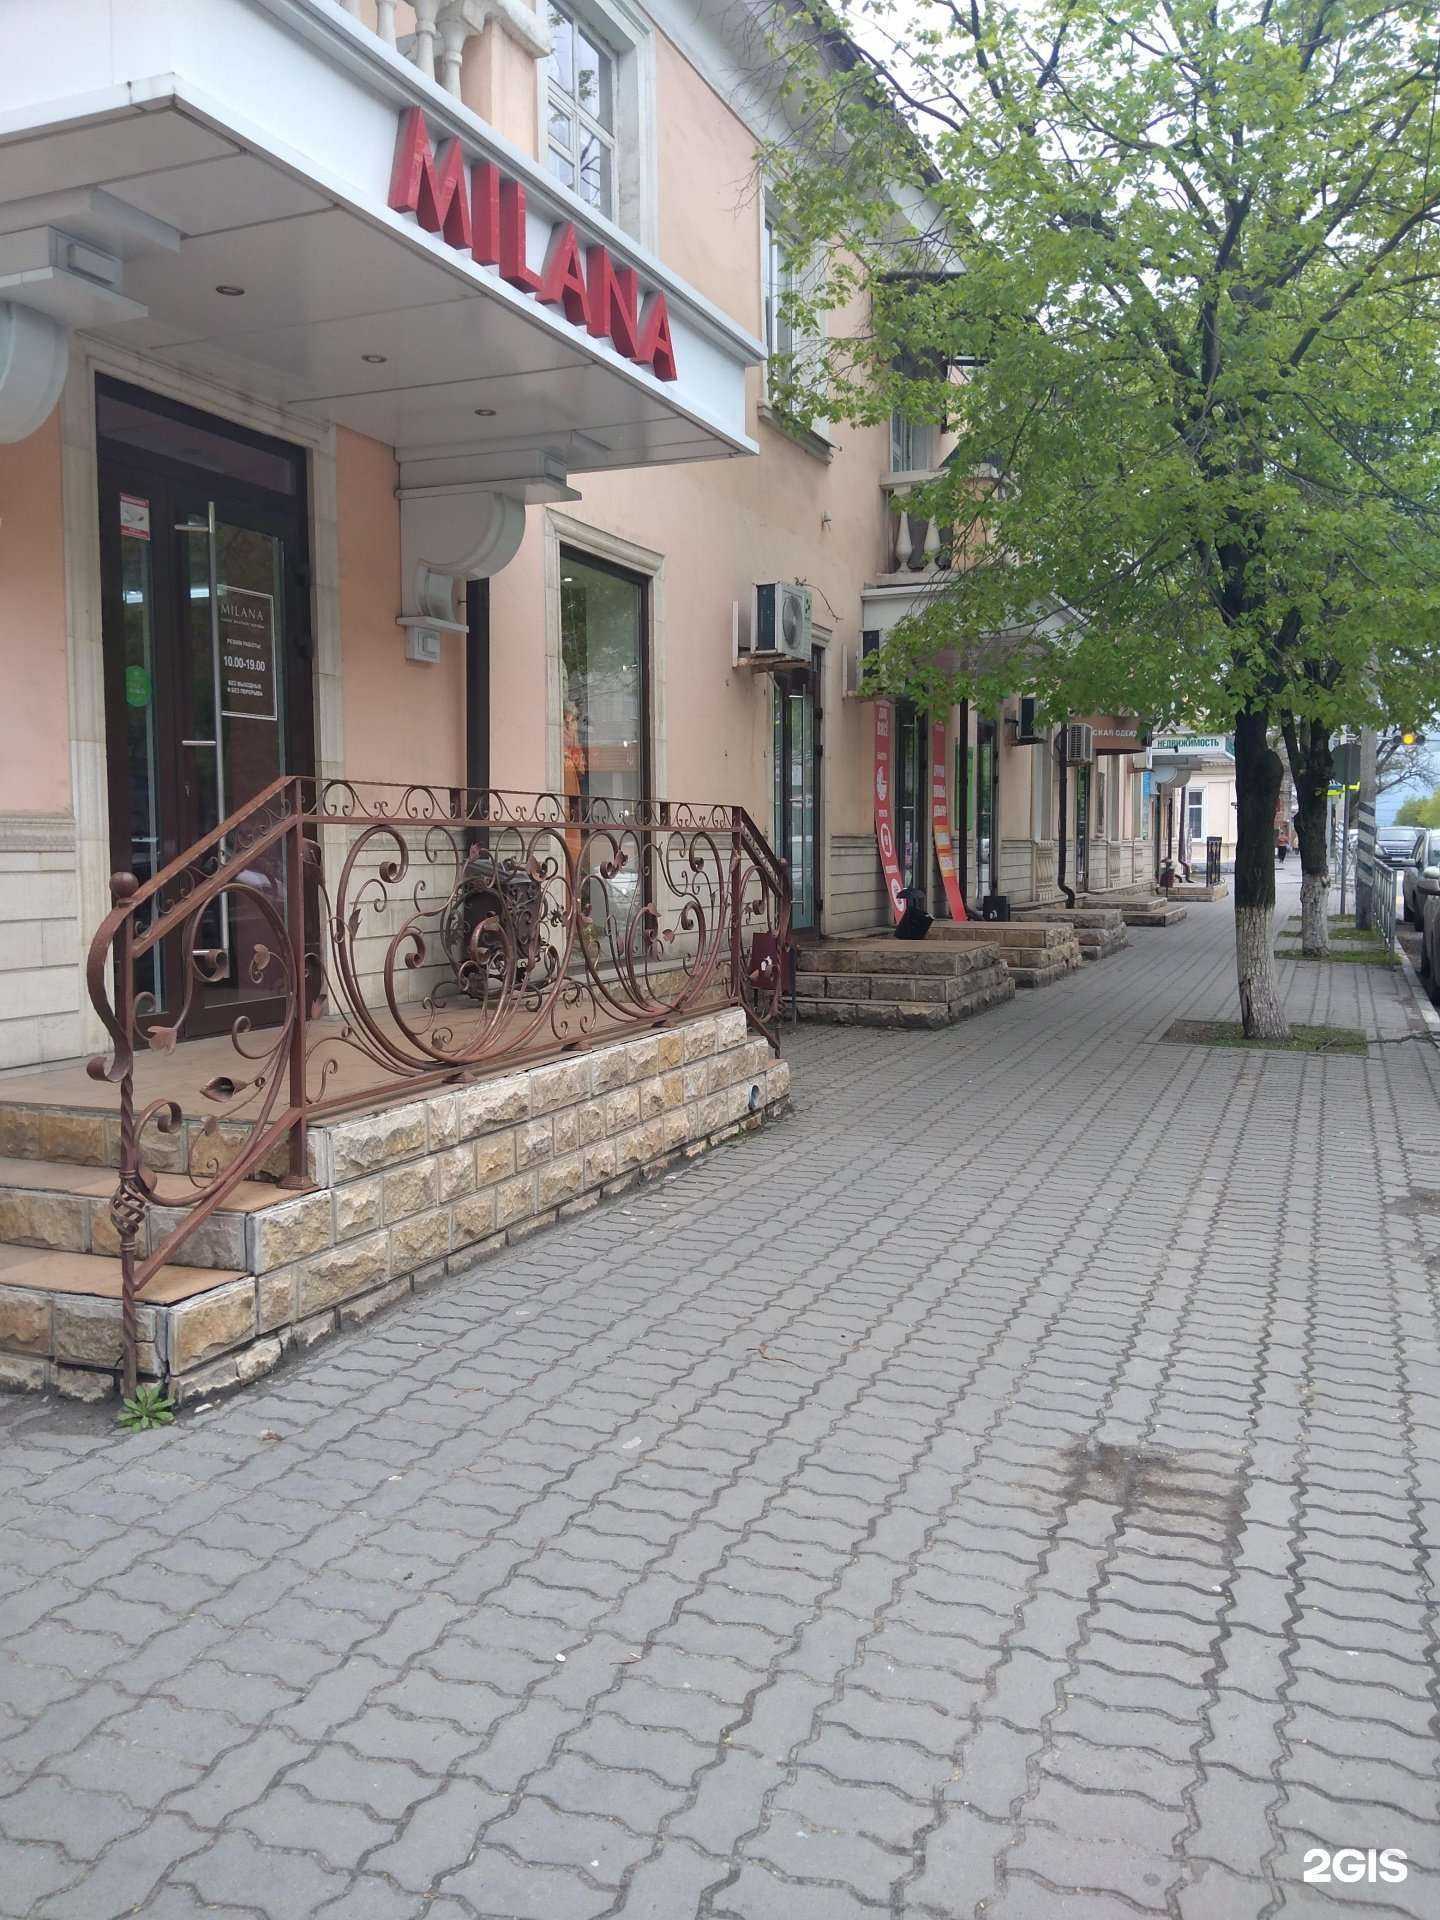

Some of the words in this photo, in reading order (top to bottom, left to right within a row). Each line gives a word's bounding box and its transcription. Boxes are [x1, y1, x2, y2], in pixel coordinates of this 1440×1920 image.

[387, 104, 678, 382] MILANA
[220, 603, 265, 621] MILANA
[1092, 728, 1114, 737] СКАЯ
[1157, 738, 1219, 749] НЕДВИЖИМОСТЬ
